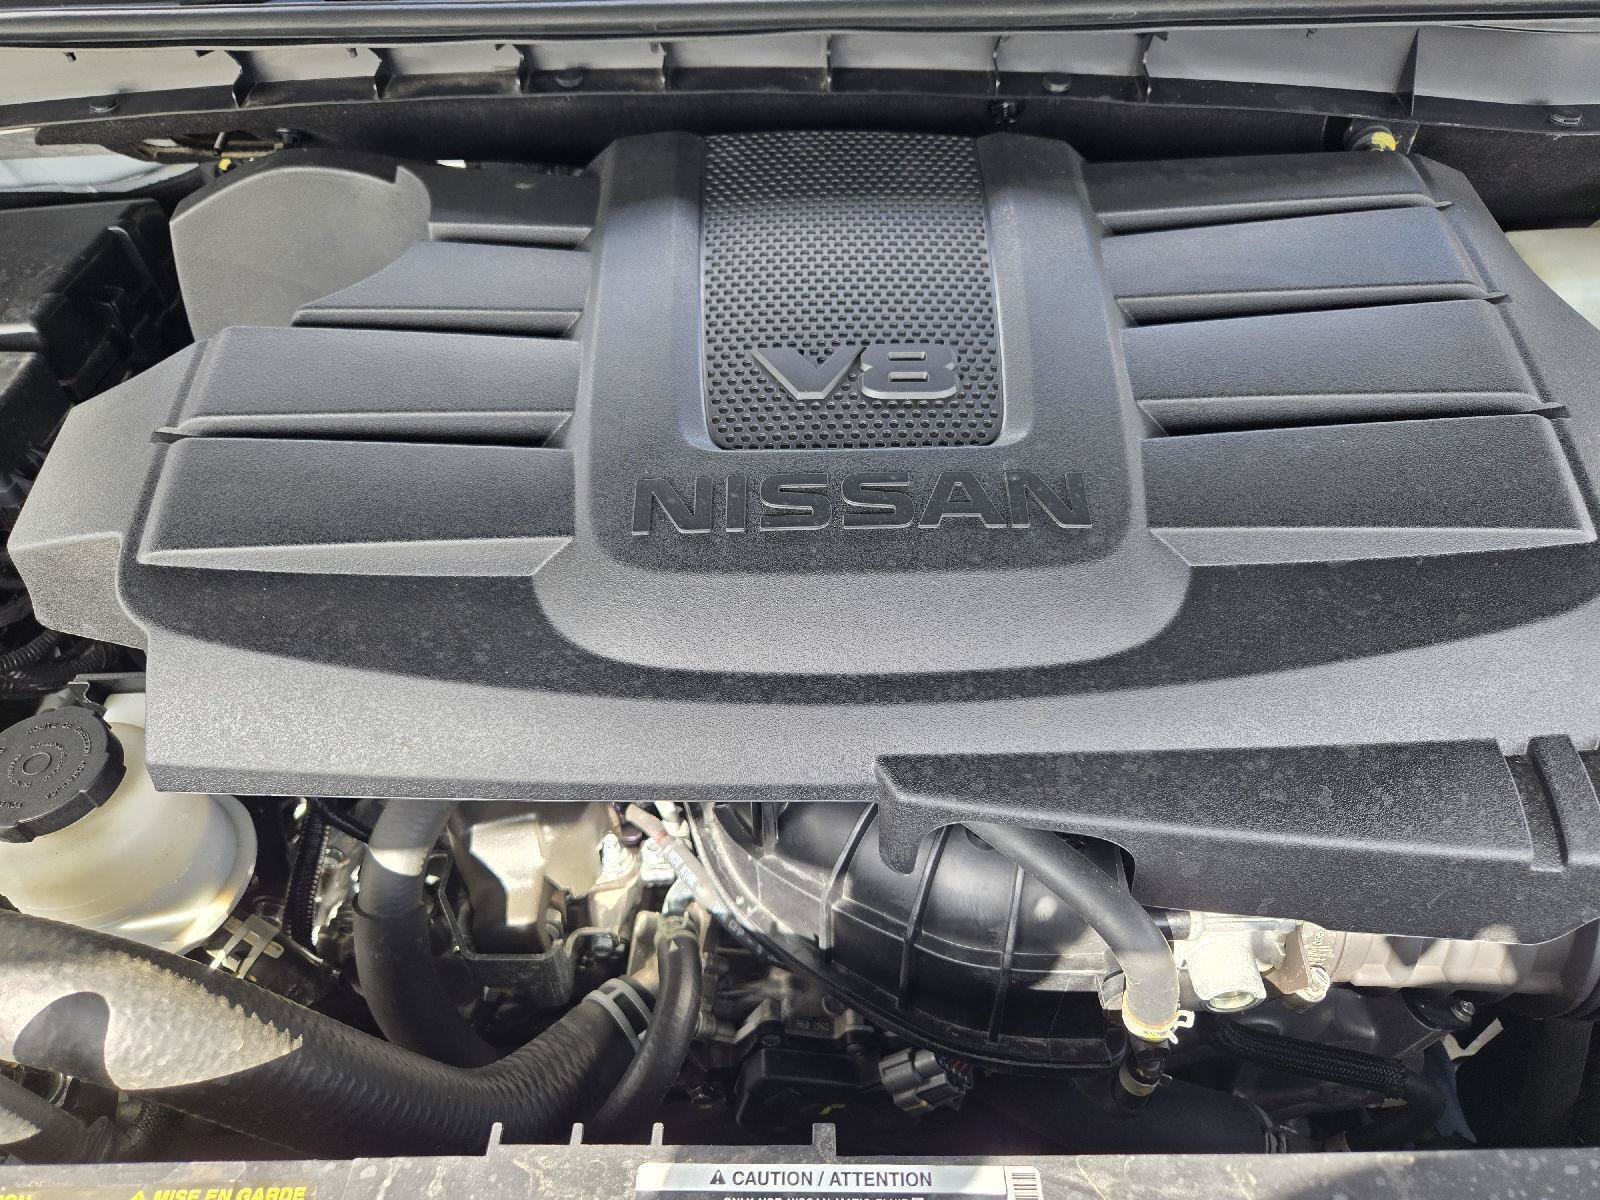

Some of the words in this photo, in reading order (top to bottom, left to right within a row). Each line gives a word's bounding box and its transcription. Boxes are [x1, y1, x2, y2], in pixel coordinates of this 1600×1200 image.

[750, 343, 960, 400] V8
[631, 470, 1093, 536] NISSAN
[732, 1170, 813, 1187] CAUTION
[829, 1171, 933, 1188] ATTENTION
